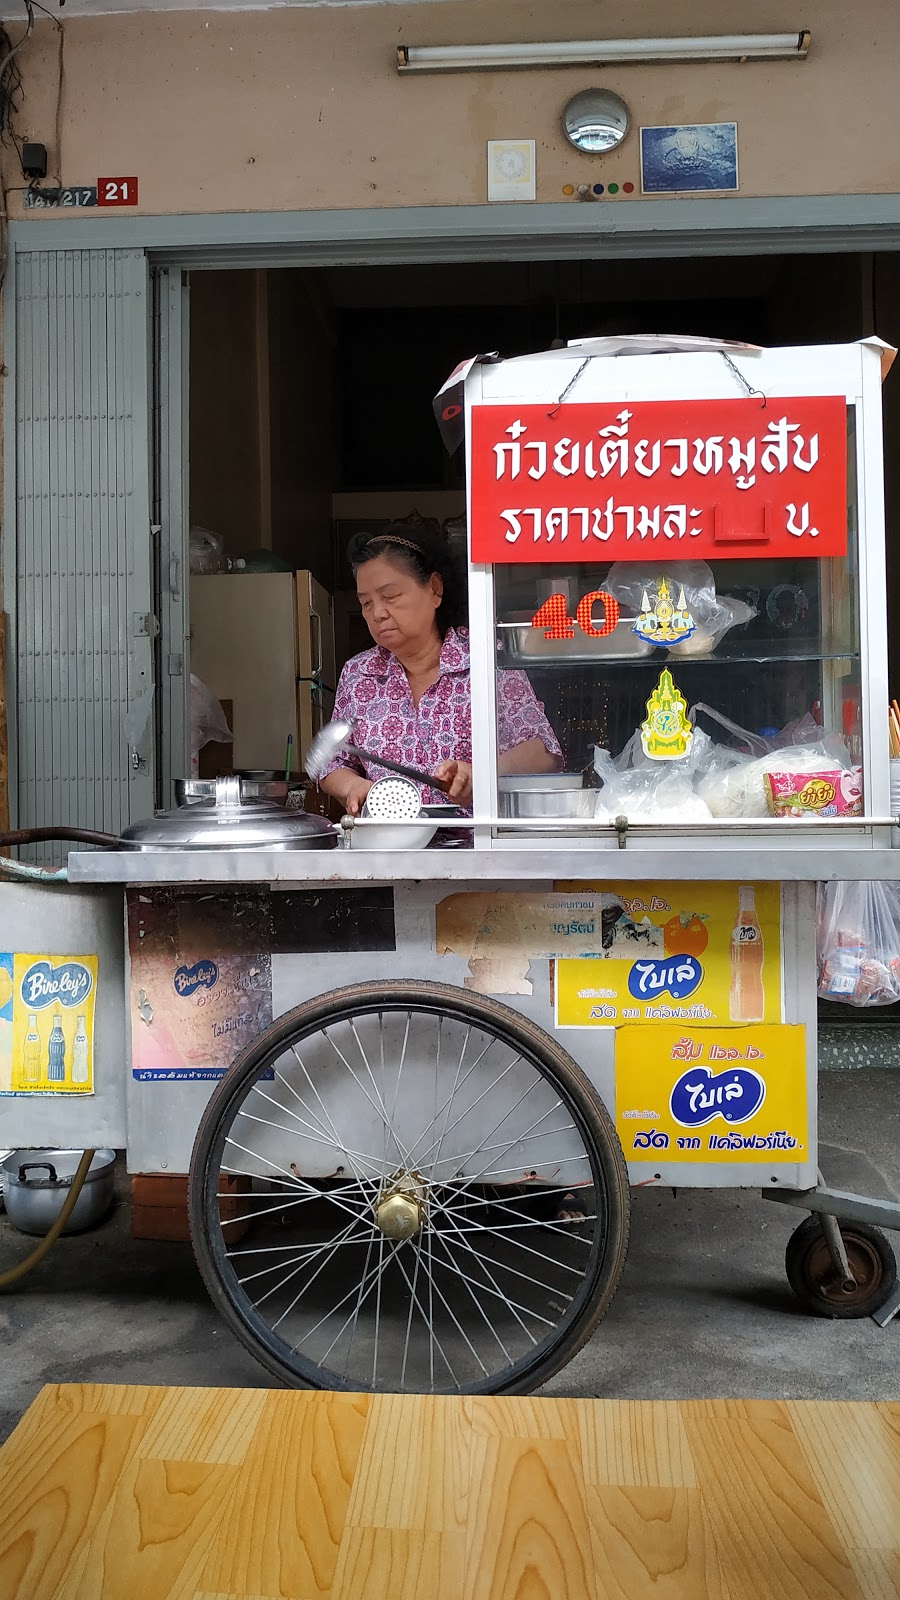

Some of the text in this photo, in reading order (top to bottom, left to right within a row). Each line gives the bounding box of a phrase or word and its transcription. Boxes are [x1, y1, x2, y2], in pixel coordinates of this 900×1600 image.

[105, 182, 128, 200] 21
[493, 409, 819, 490] ก๋วยเตี๋ยวหมูสับ
[500, 496, 820, 543] ราคาชามละ บ.
[531, 590, 620, 640] 40
[798, 783, 836, 806] ยำยำ
[28, 971, 88, 1002] Bireley's
[635, 957, 696, 993] ไบเล่
[589, 1003, 618, 1019] สด
[670, 1038, 703, 1061] ส้ม
[684, 1075, 744, 1113] ไบเล่
[633, 1129, 669, 1149] สด
[676, 1138, 701, 1150] จาก
